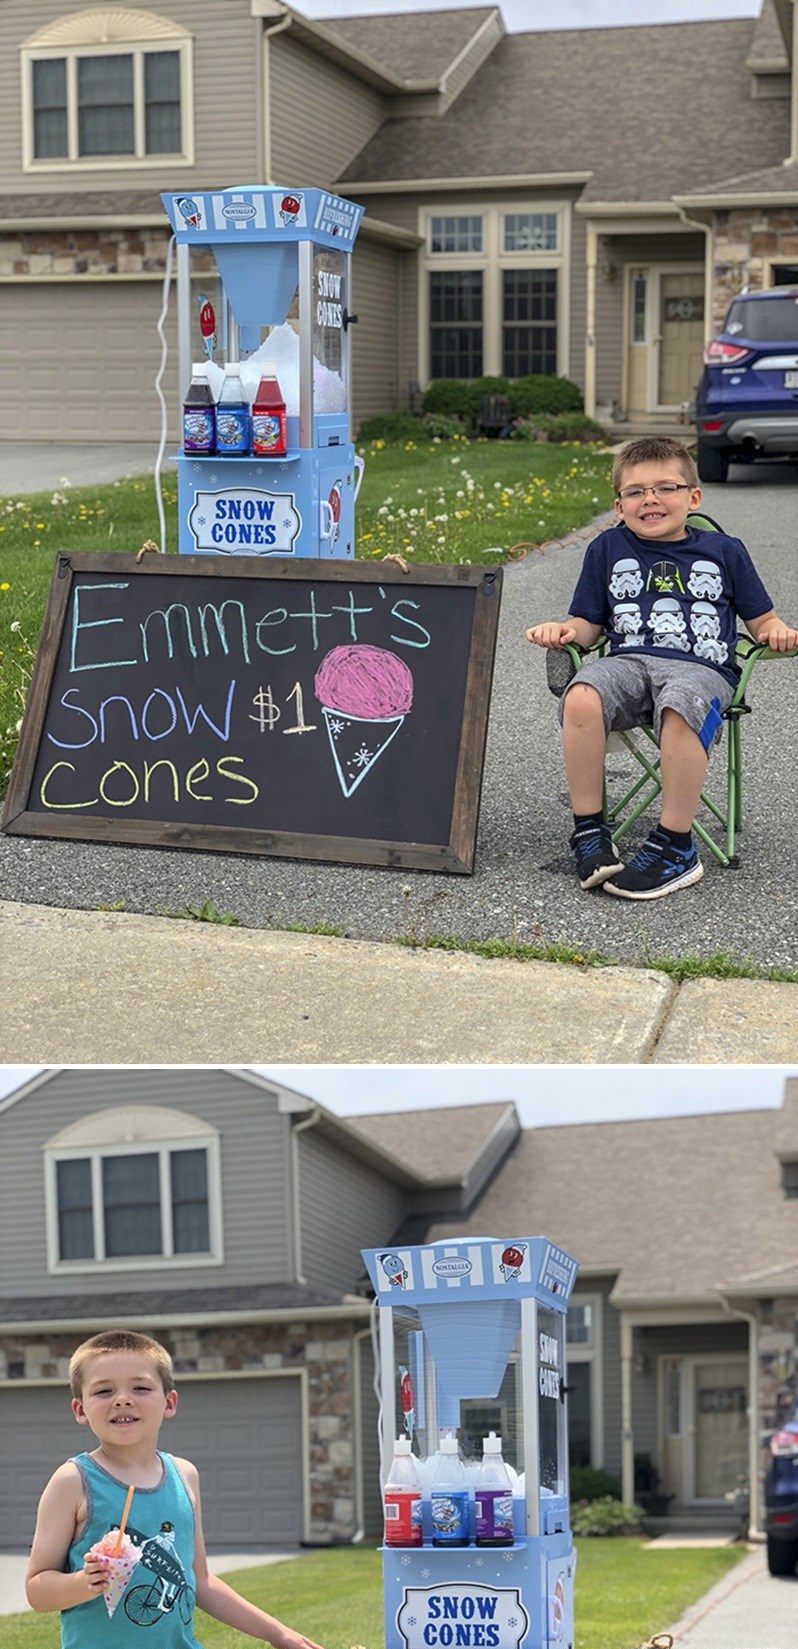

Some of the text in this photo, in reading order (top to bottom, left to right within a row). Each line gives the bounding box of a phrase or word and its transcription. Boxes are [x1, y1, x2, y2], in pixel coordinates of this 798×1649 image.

[318, 270, 341, 299] SNOW
[317, 301, 342, 329] CONES
[215, 499, 275, 521] SNOW
[211, 524, 276, 545] CONES
[70, 583, 431, 673] Emmett's
[248, 681, 317, 735] $1
[435, 1263, 470, 1272] NOSTALGIA
[428, 1596, 498, 1619] SNOW
[423, 1623, 500, 1647] CONES
